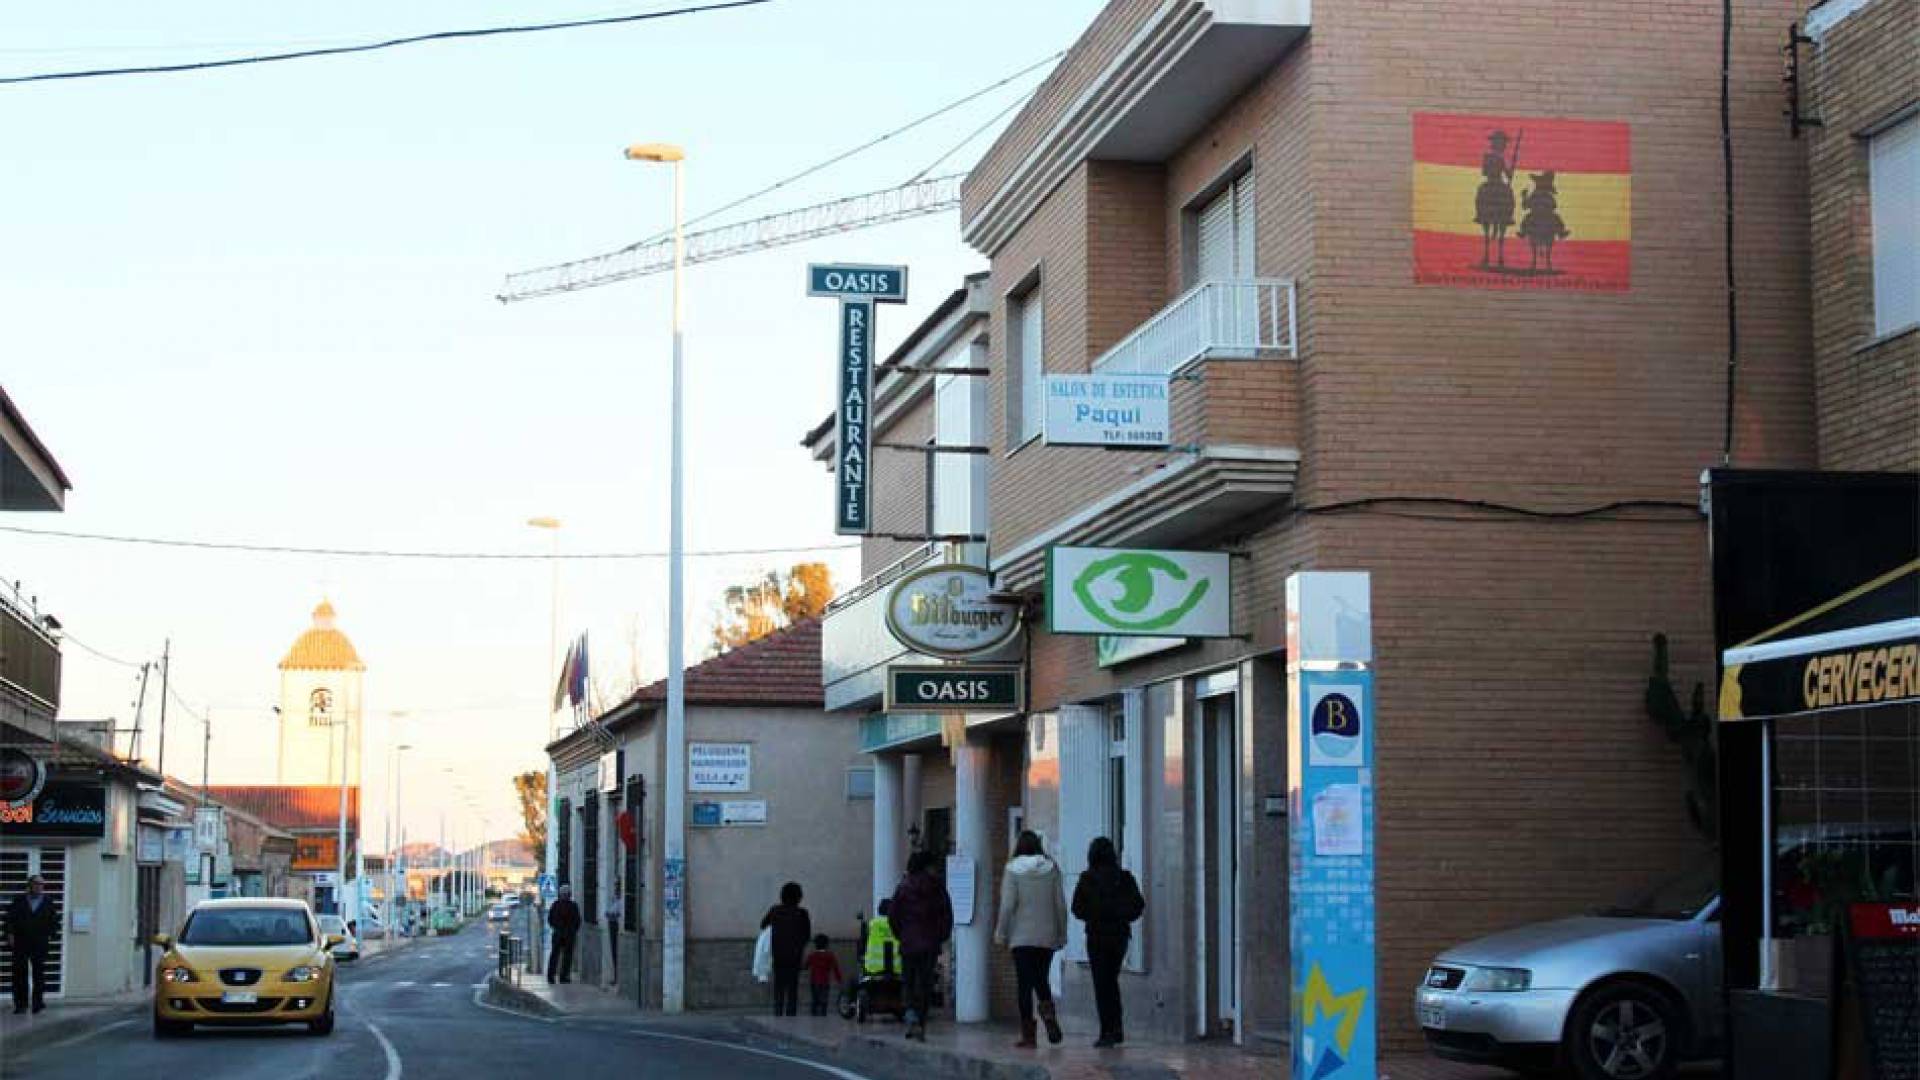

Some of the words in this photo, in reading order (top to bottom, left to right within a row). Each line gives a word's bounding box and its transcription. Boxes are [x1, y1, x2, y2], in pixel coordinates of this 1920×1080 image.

[824, 272, 888, 293] OASIS
[845, 308, 865, 521] RESTAURANTE
[1075, 403, 1141, 427] Paqui
[918, 679, 990, 700] OASIS
[1325, 699, 1348, 730] B
[37, 800, 102, 824] Servicios
